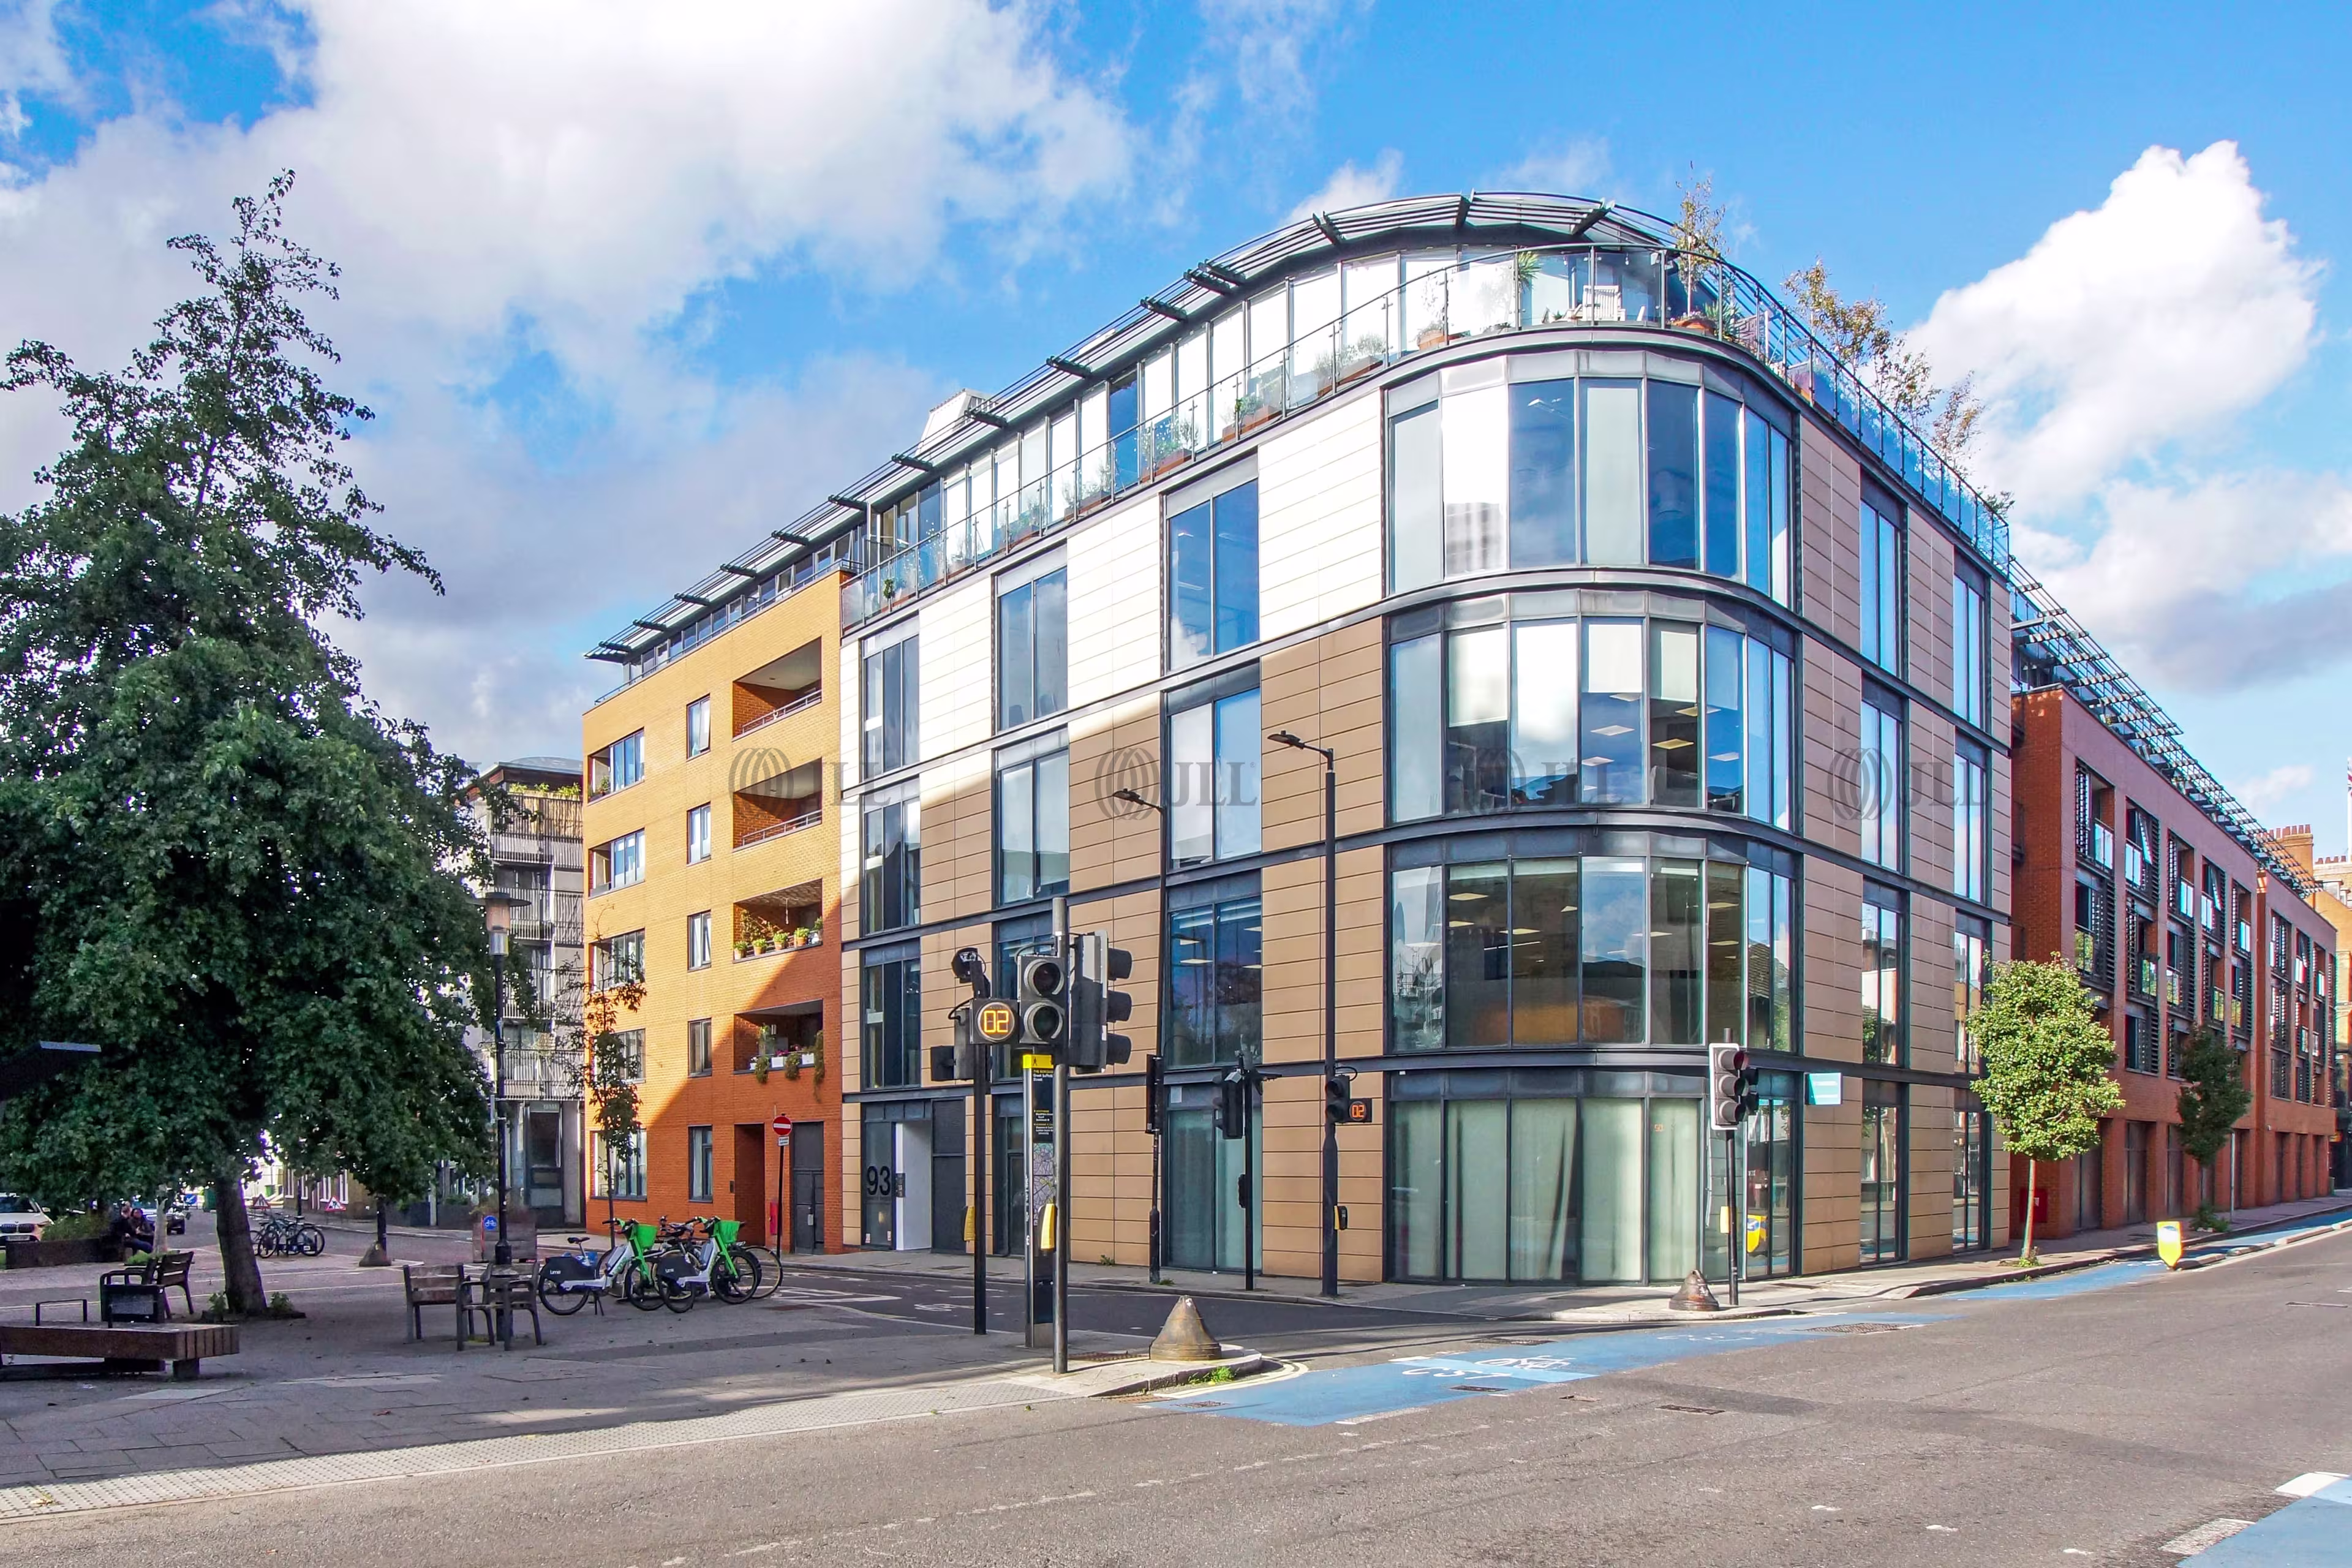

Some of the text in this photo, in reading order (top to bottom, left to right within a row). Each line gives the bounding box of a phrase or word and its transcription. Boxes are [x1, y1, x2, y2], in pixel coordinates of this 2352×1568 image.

[984, 1010, 1009, 1033] 02
[1352, 1104, 1365, 1118] 02
[867, 1166, 891, 1196] 93
